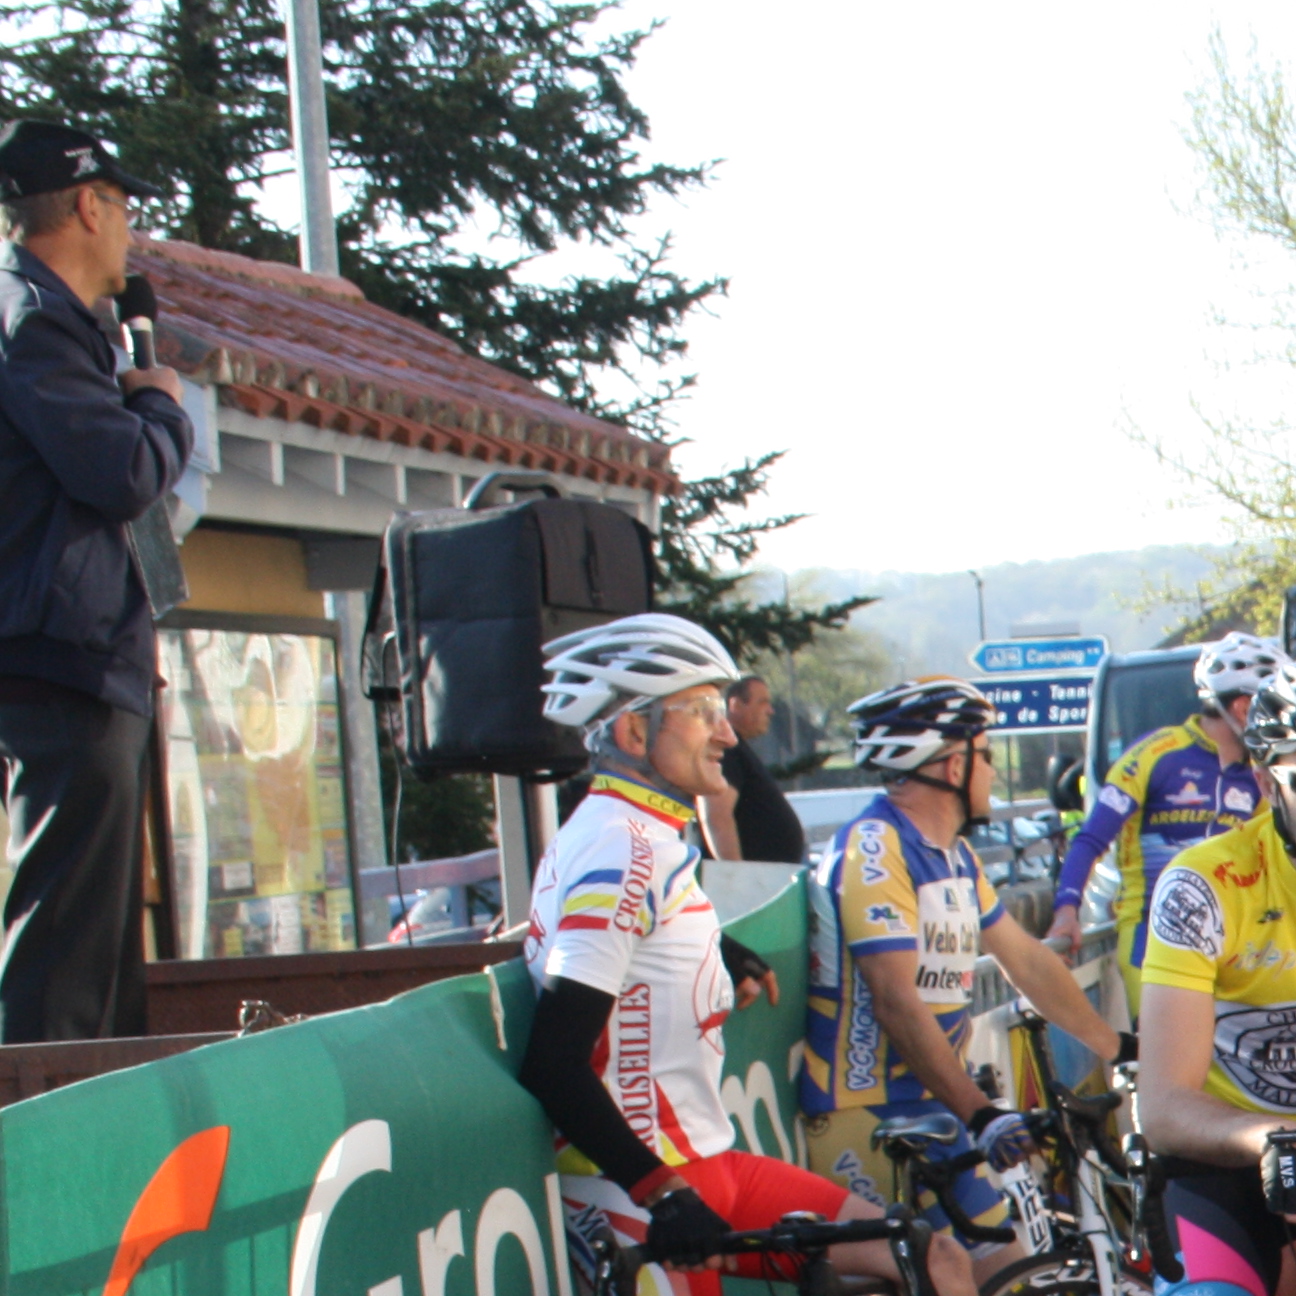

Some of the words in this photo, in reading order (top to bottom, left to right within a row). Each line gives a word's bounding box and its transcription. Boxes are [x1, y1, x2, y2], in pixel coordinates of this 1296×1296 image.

[1026, 648, 1085, 665] Camping
[1050, 683, 1093, 701] Tenni
[1049, 705, 1087, 724] Spor
